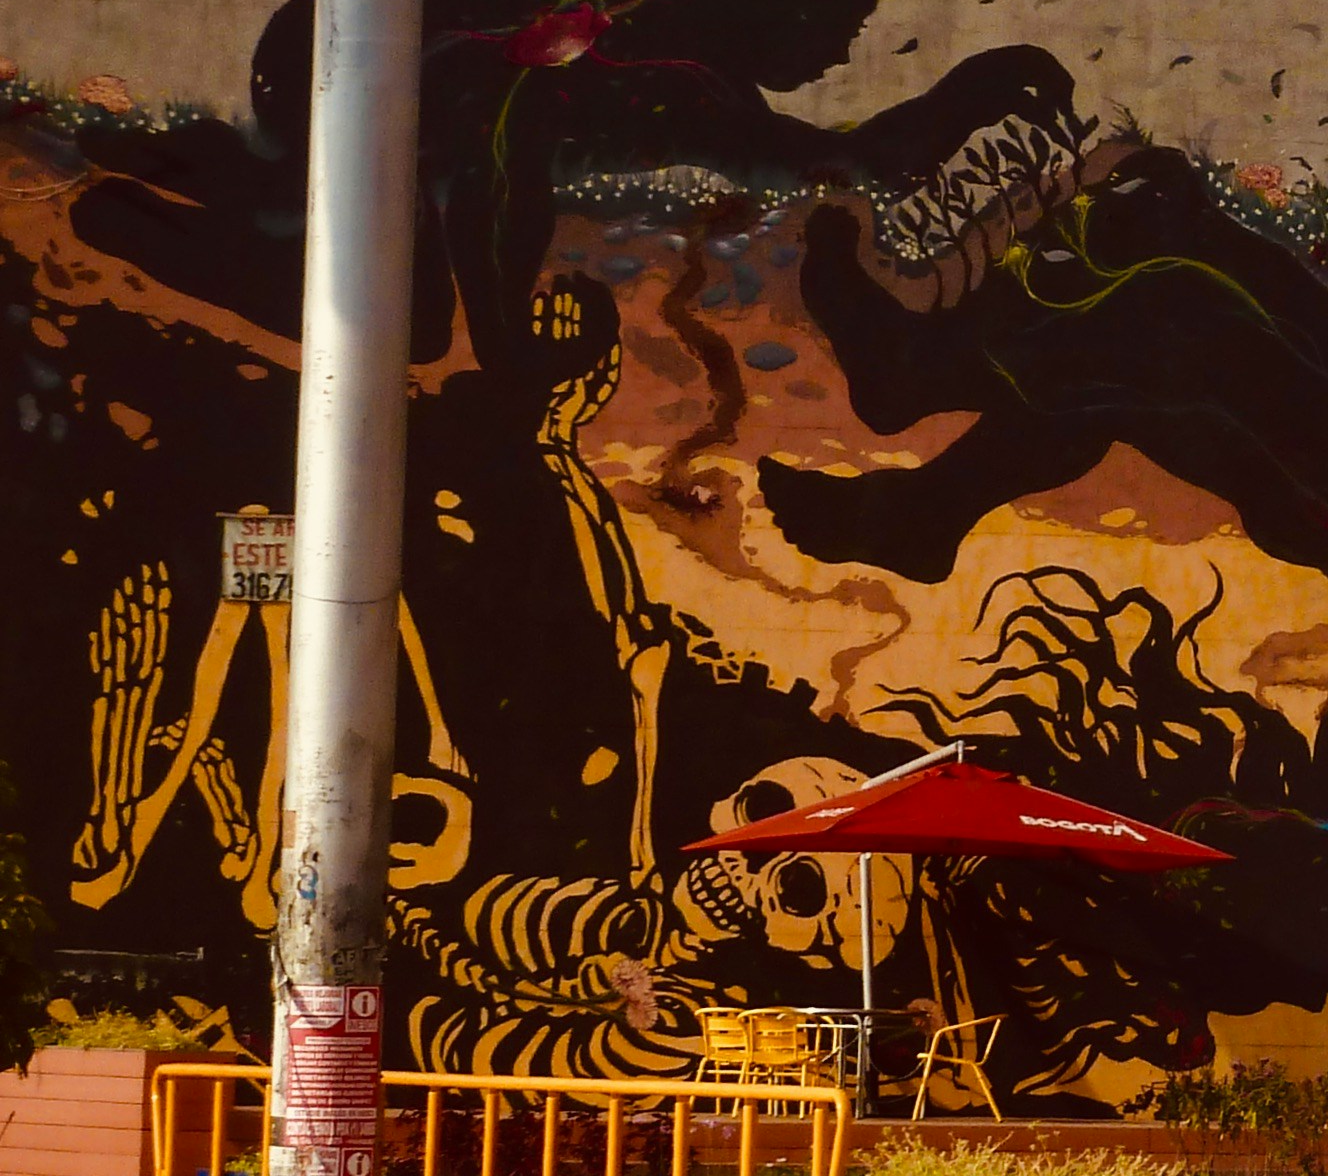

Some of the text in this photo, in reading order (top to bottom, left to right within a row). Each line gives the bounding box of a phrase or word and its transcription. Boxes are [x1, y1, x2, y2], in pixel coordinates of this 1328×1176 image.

[241, 518, 265, 536] SE
[232, 542, 288, 566] ESTE
[231, 572, 293, 600] 3167
